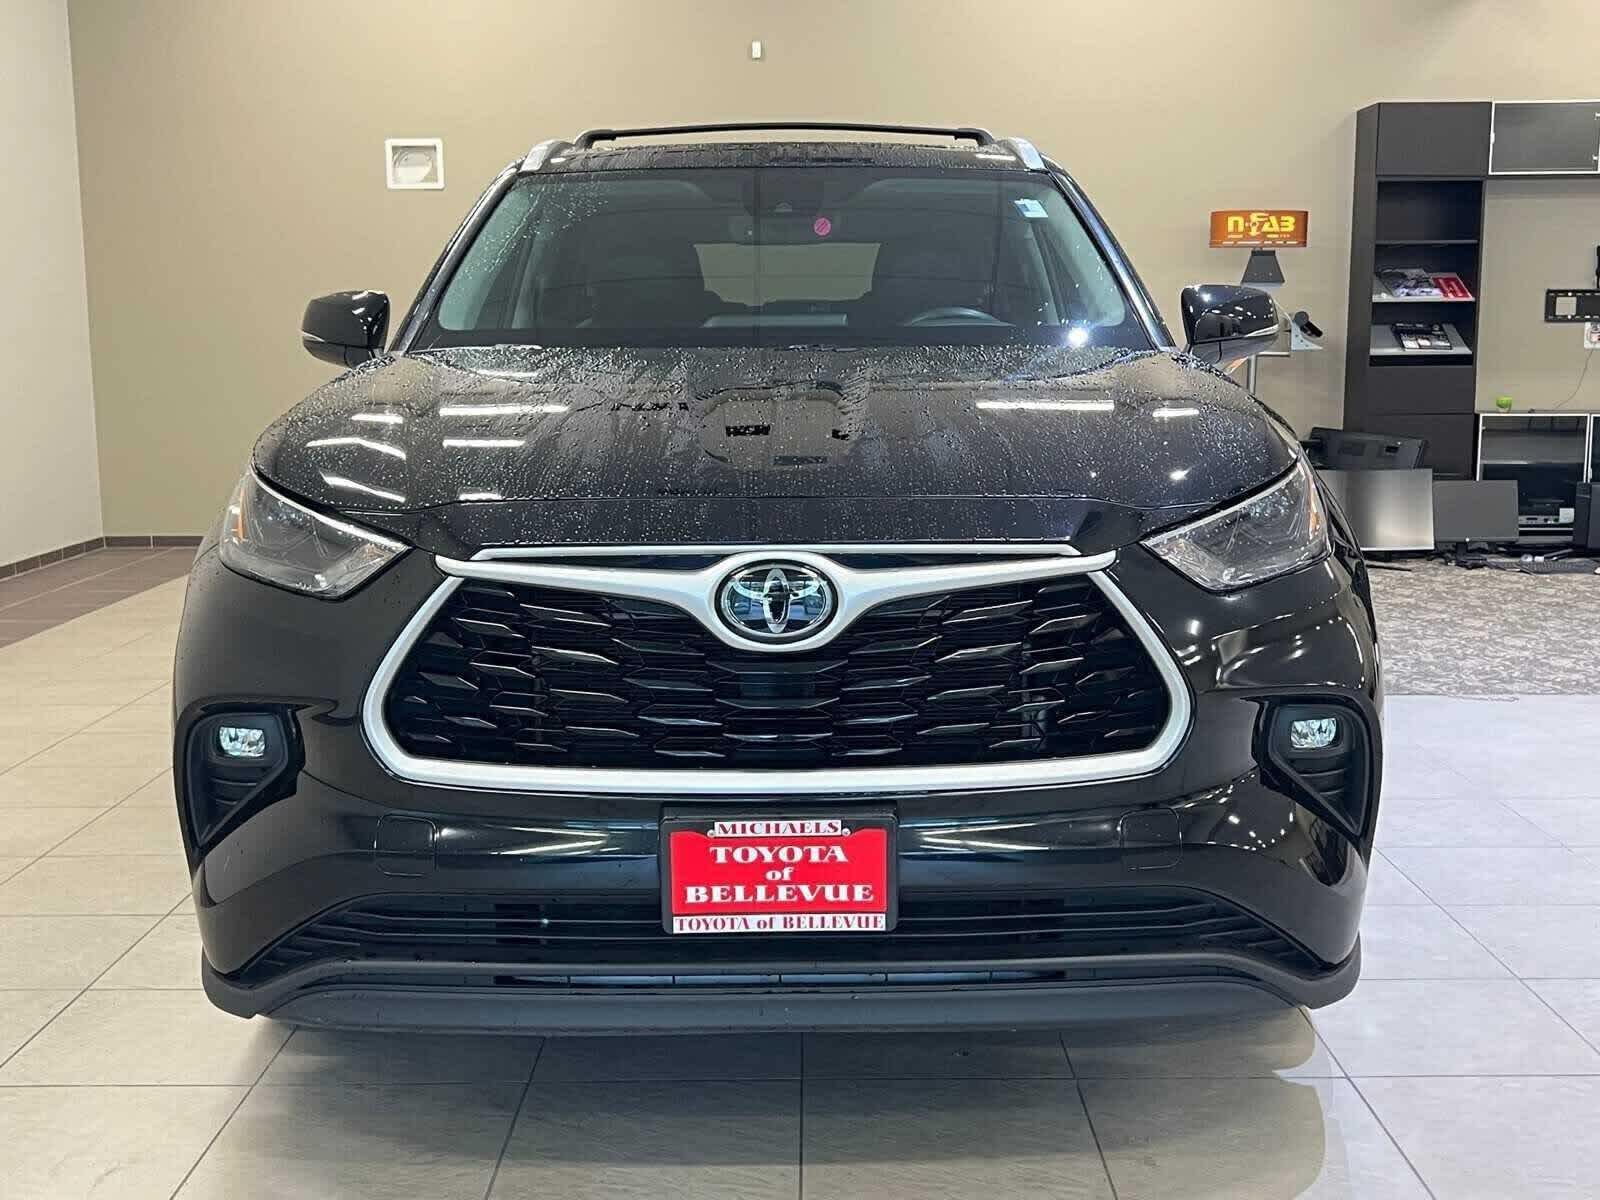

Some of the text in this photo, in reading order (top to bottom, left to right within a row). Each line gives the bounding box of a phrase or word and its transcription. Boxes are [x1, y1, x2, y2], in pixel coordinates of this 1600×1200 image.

[718, 821, 840, 835] MICHAELS
[709, 845, 848, 864] TOYOTA
[765, 866, 795, 881] of
[684, 884, 874, 904] BELLEVUE
[675, 915, 885, 931] TOYOTA of BELLEVUE
